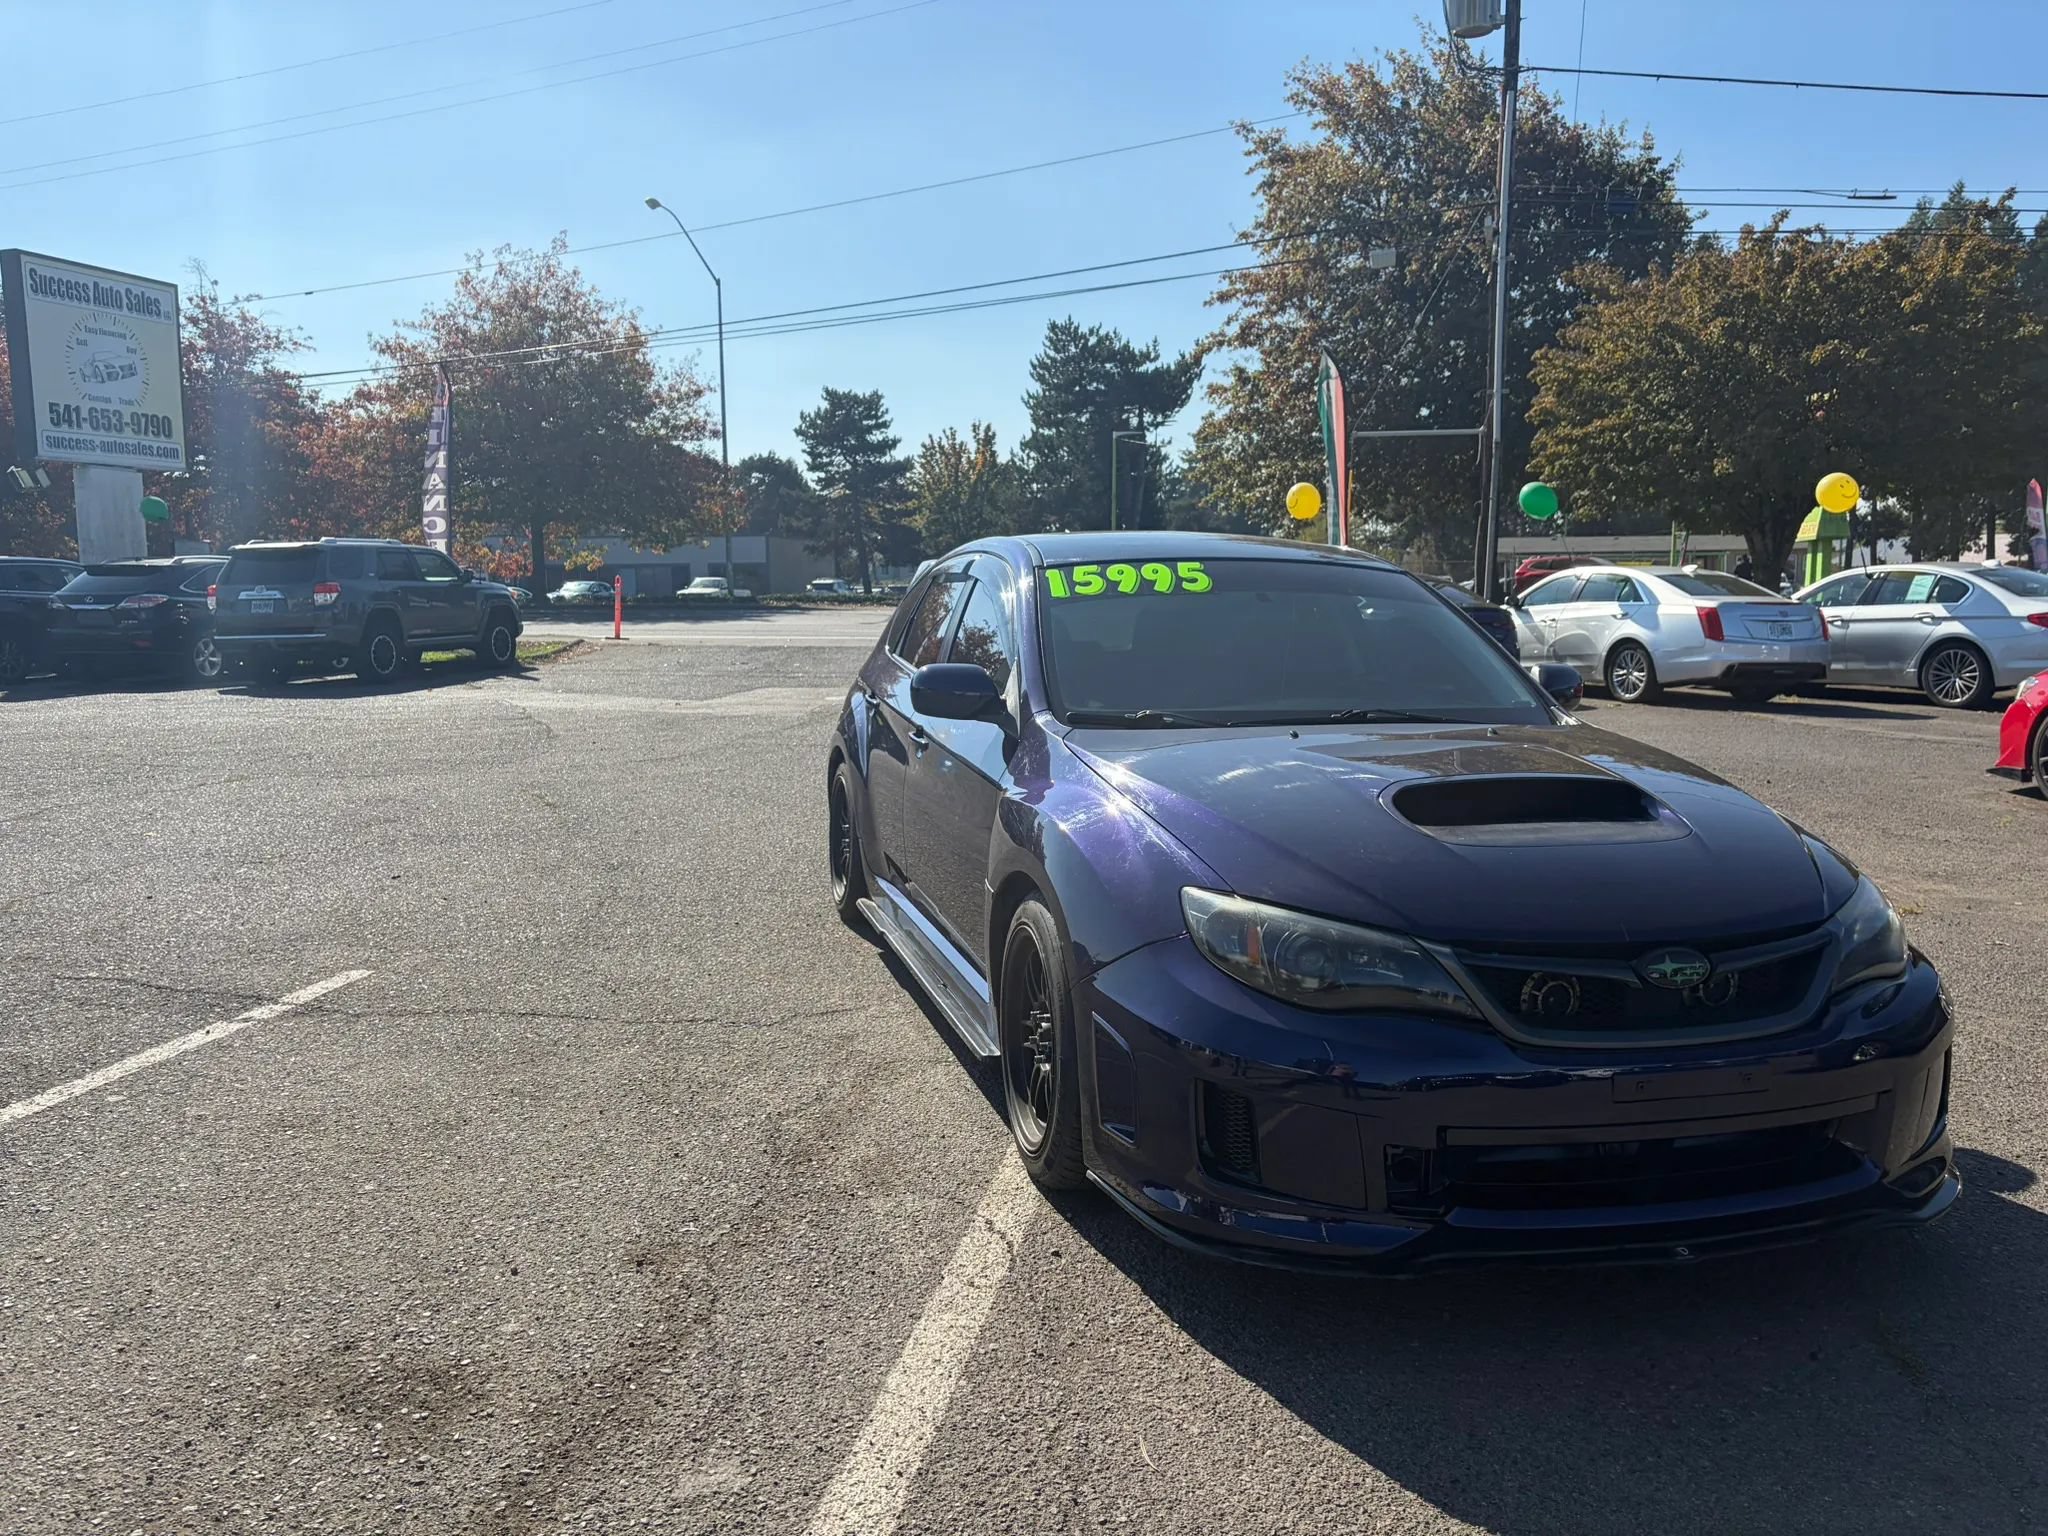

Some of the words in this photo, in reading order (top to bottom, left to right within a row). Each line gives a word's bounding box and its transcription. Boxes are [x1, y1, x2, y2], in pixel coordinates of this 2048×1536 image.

[29, 267, 91, 305] Success
[93, 280, 123, 312] Auto
[125, 287, 161, 318] Sales
[48, 401, 173, 440] 541-653-9790
[45, 435, 180, 460] success-autosales.com
[1045, 561, 1213, 599] 15995
